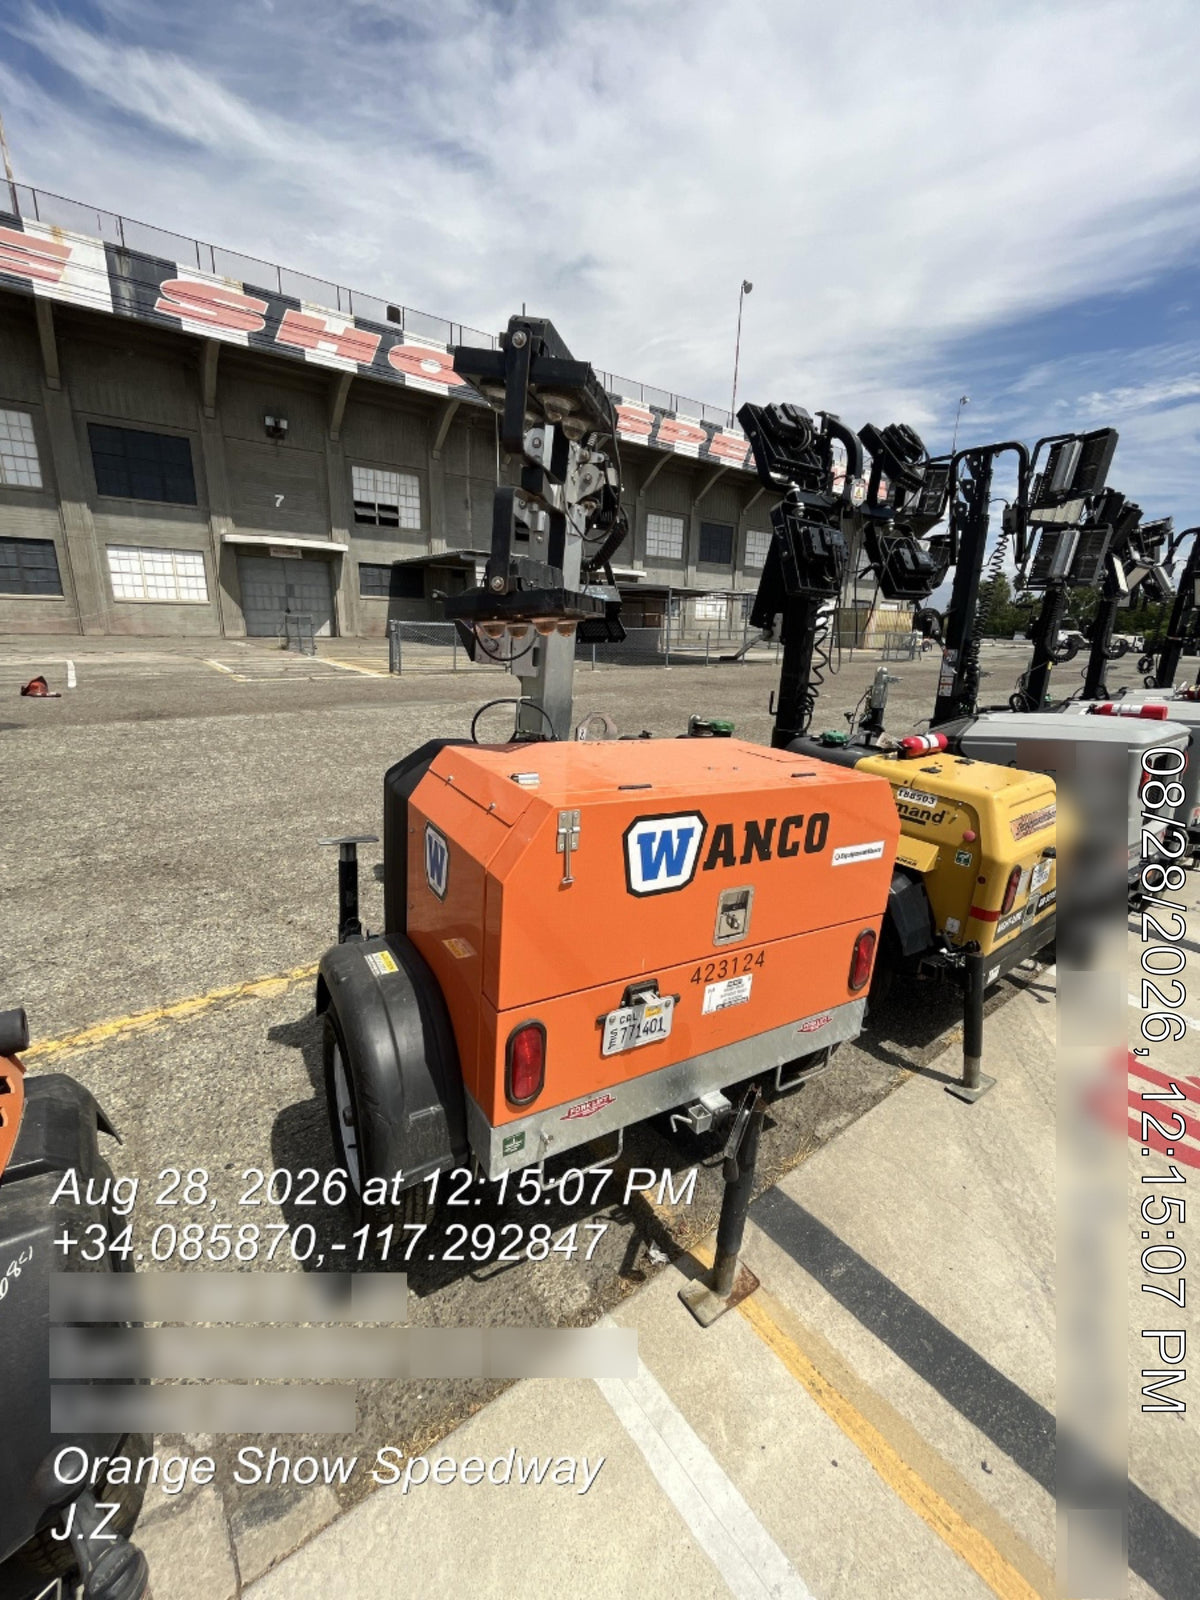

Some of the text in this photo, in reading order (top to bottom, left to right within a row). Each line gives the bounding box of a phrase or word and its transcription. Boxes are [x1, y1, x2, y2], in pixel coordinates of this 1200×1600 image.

[154, 279, 467, 387] SHO
[274, 494, 285, 507] 7
[896, 803, 946, 824] mand
[427, 833, 447, 888] W
[634, 812, 830, 883] WANCO
[690, 950, 765, 984] 423124
[619, 1013, 638, 1025] CAL
[620, 1016, 664, 1043] 771401
